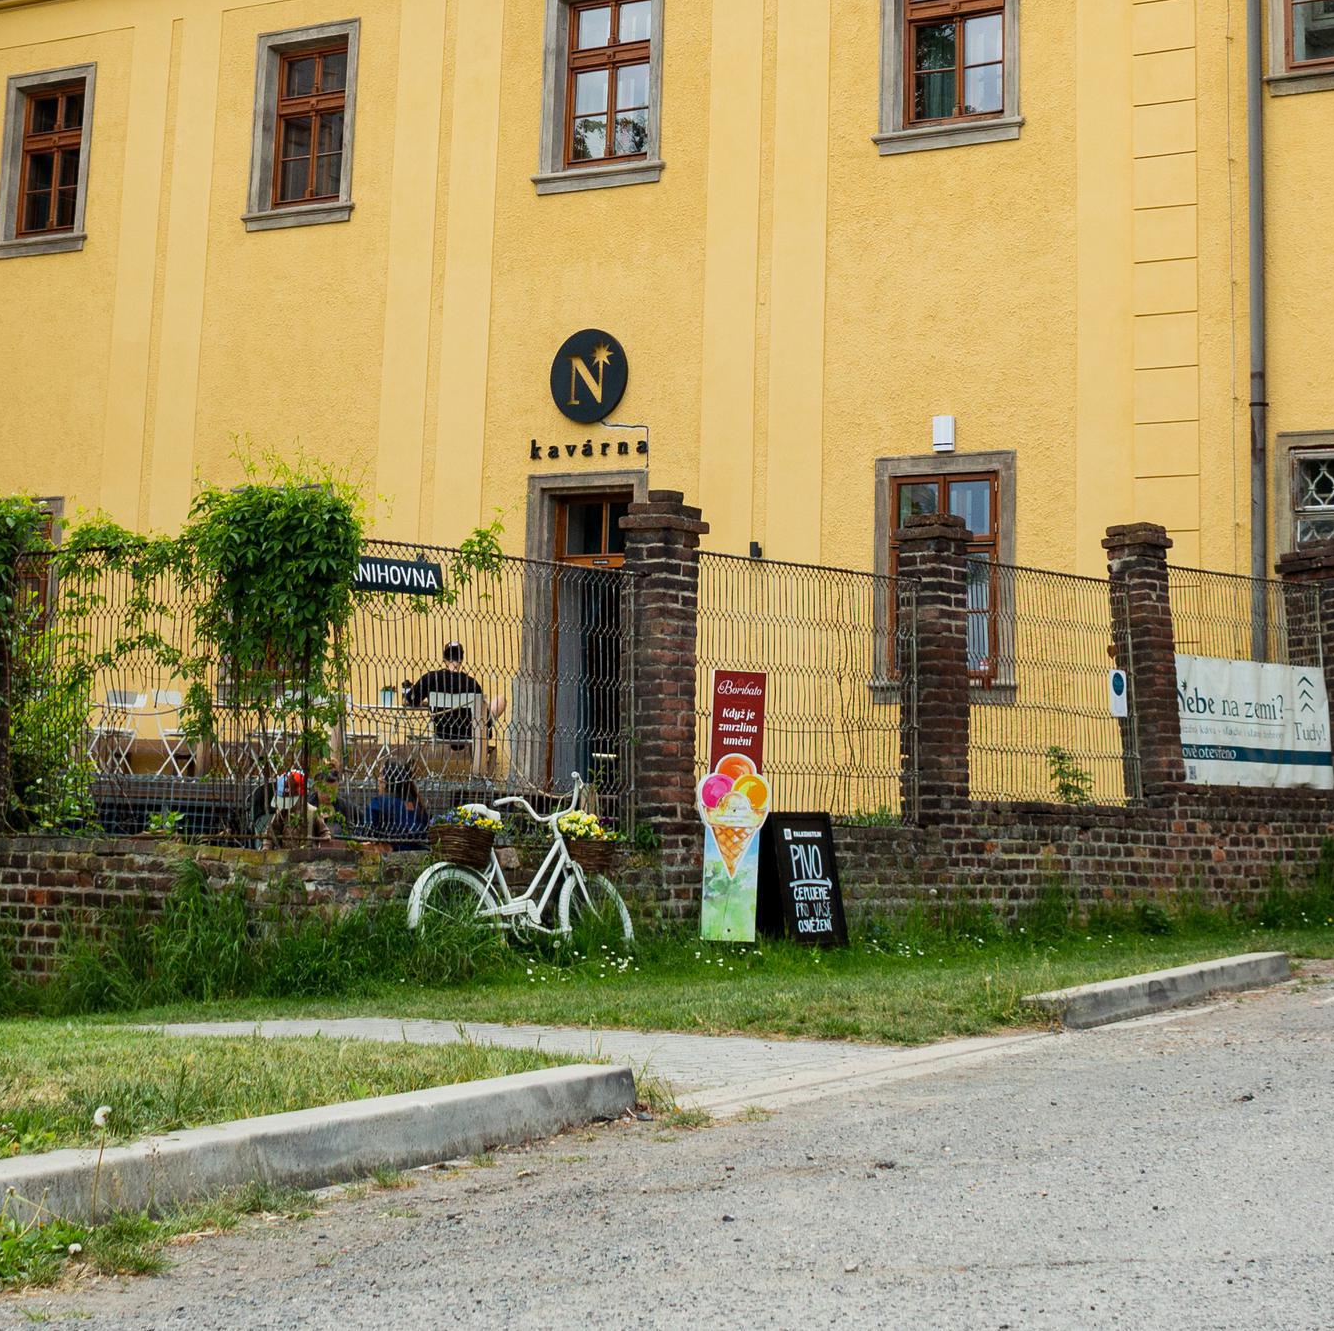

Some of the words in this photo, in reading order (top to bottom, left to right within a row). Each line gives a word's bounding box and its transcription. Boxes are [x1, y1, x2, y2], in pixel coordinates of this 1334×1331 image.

[530, 439, 648, 460] kavárna
[352, 563, 438, 589] NIHOVNA
[722, 708, 745, 721] Když
[746, 709, 755, 721] je
[1222, 698, 1239, 717] na
[1245, 694, 1284, 720] zemi?
[718, 722, 758, 733] zmrzlina
[1294, 722, 1327, 746] Tudy!
[723, 736, 753, 746] umění
[1182, 745, 1198, 758] ově
[789, 844, 823, 879] PIVO
[795, 902, 809, 917] PRO
